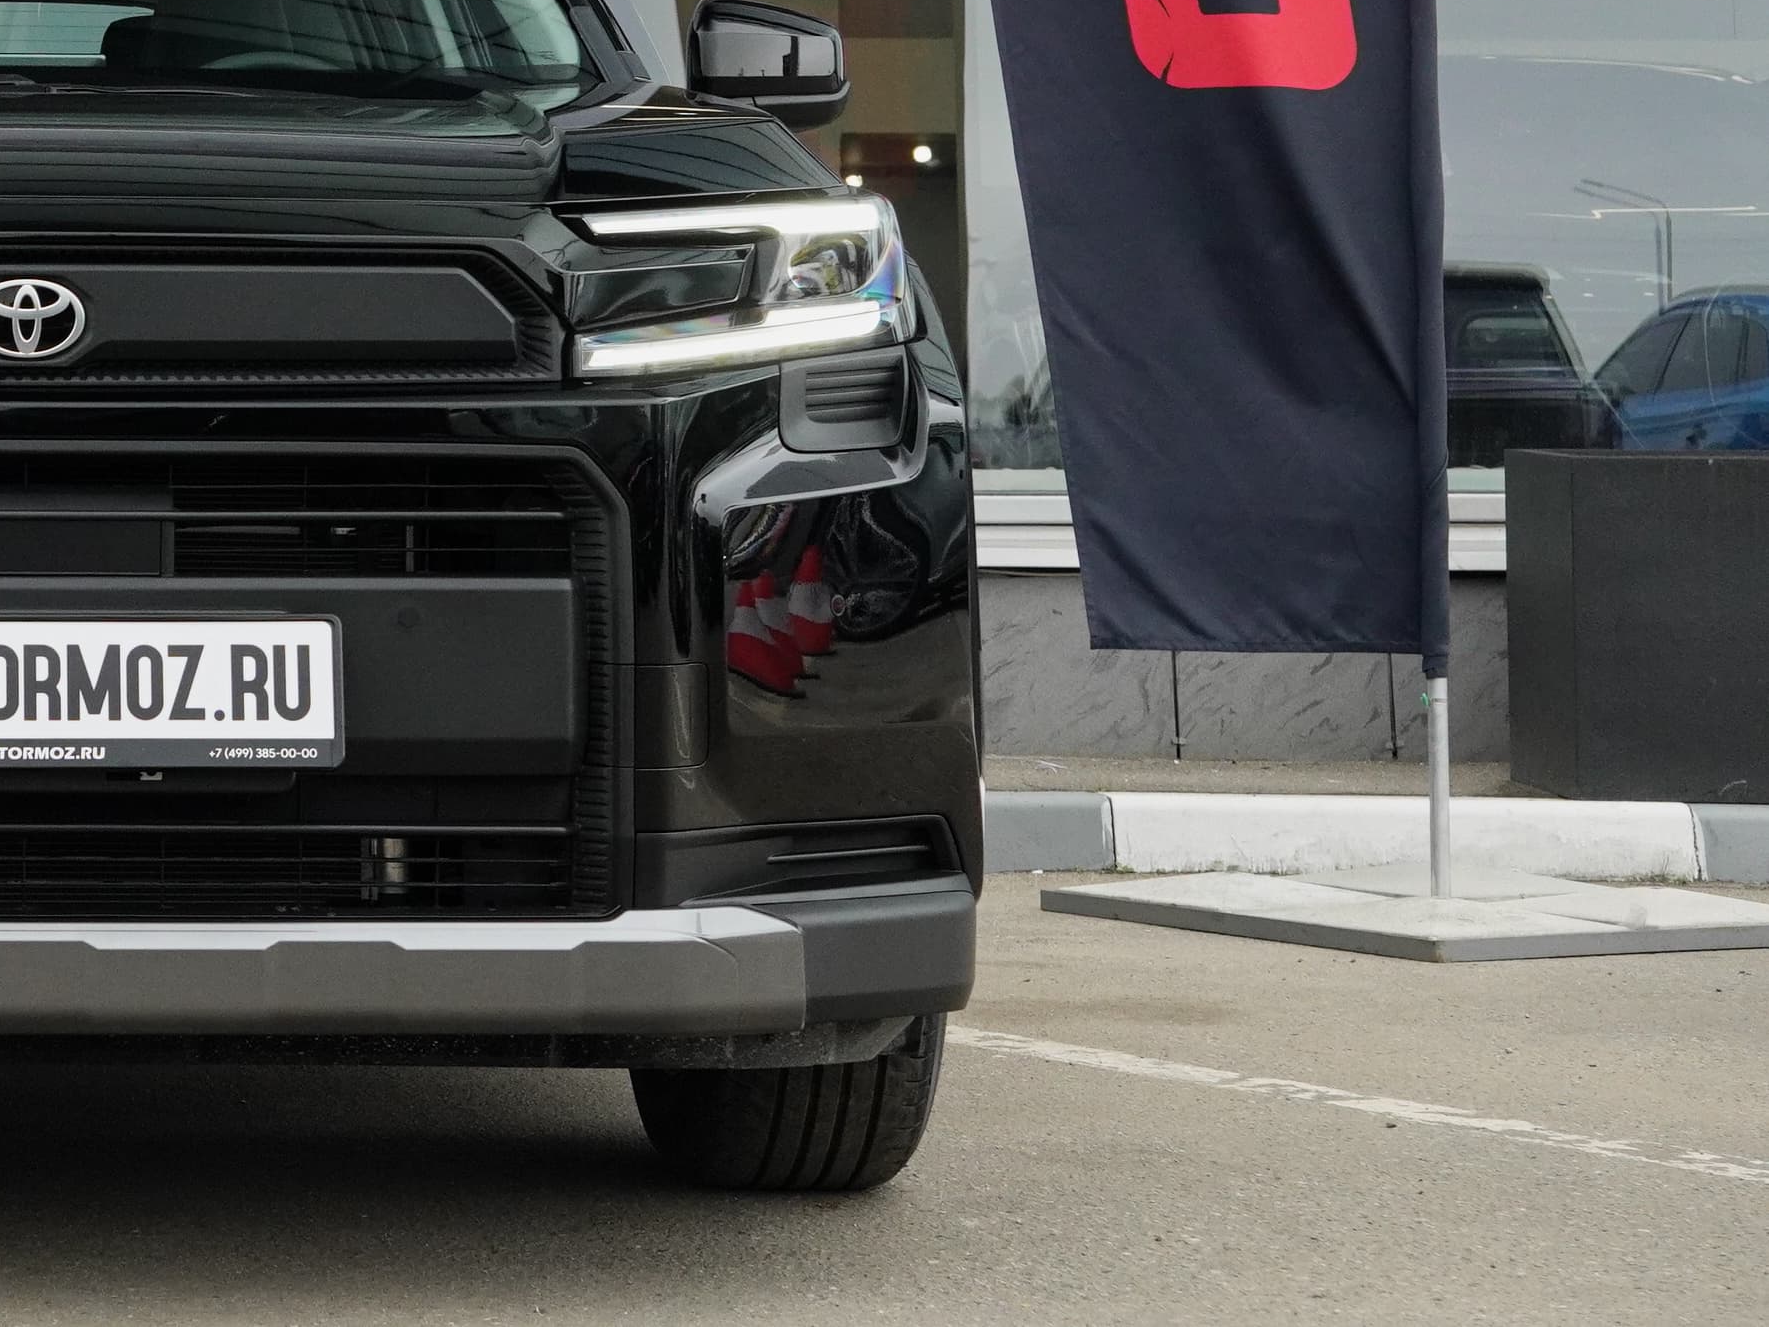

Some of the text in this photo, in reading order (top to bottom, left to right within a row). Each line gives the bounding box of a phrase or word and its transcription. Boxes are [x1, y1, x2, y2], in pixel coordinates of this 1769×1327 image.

[209, 746, 318, 761] +7 (499) 385-00-00
